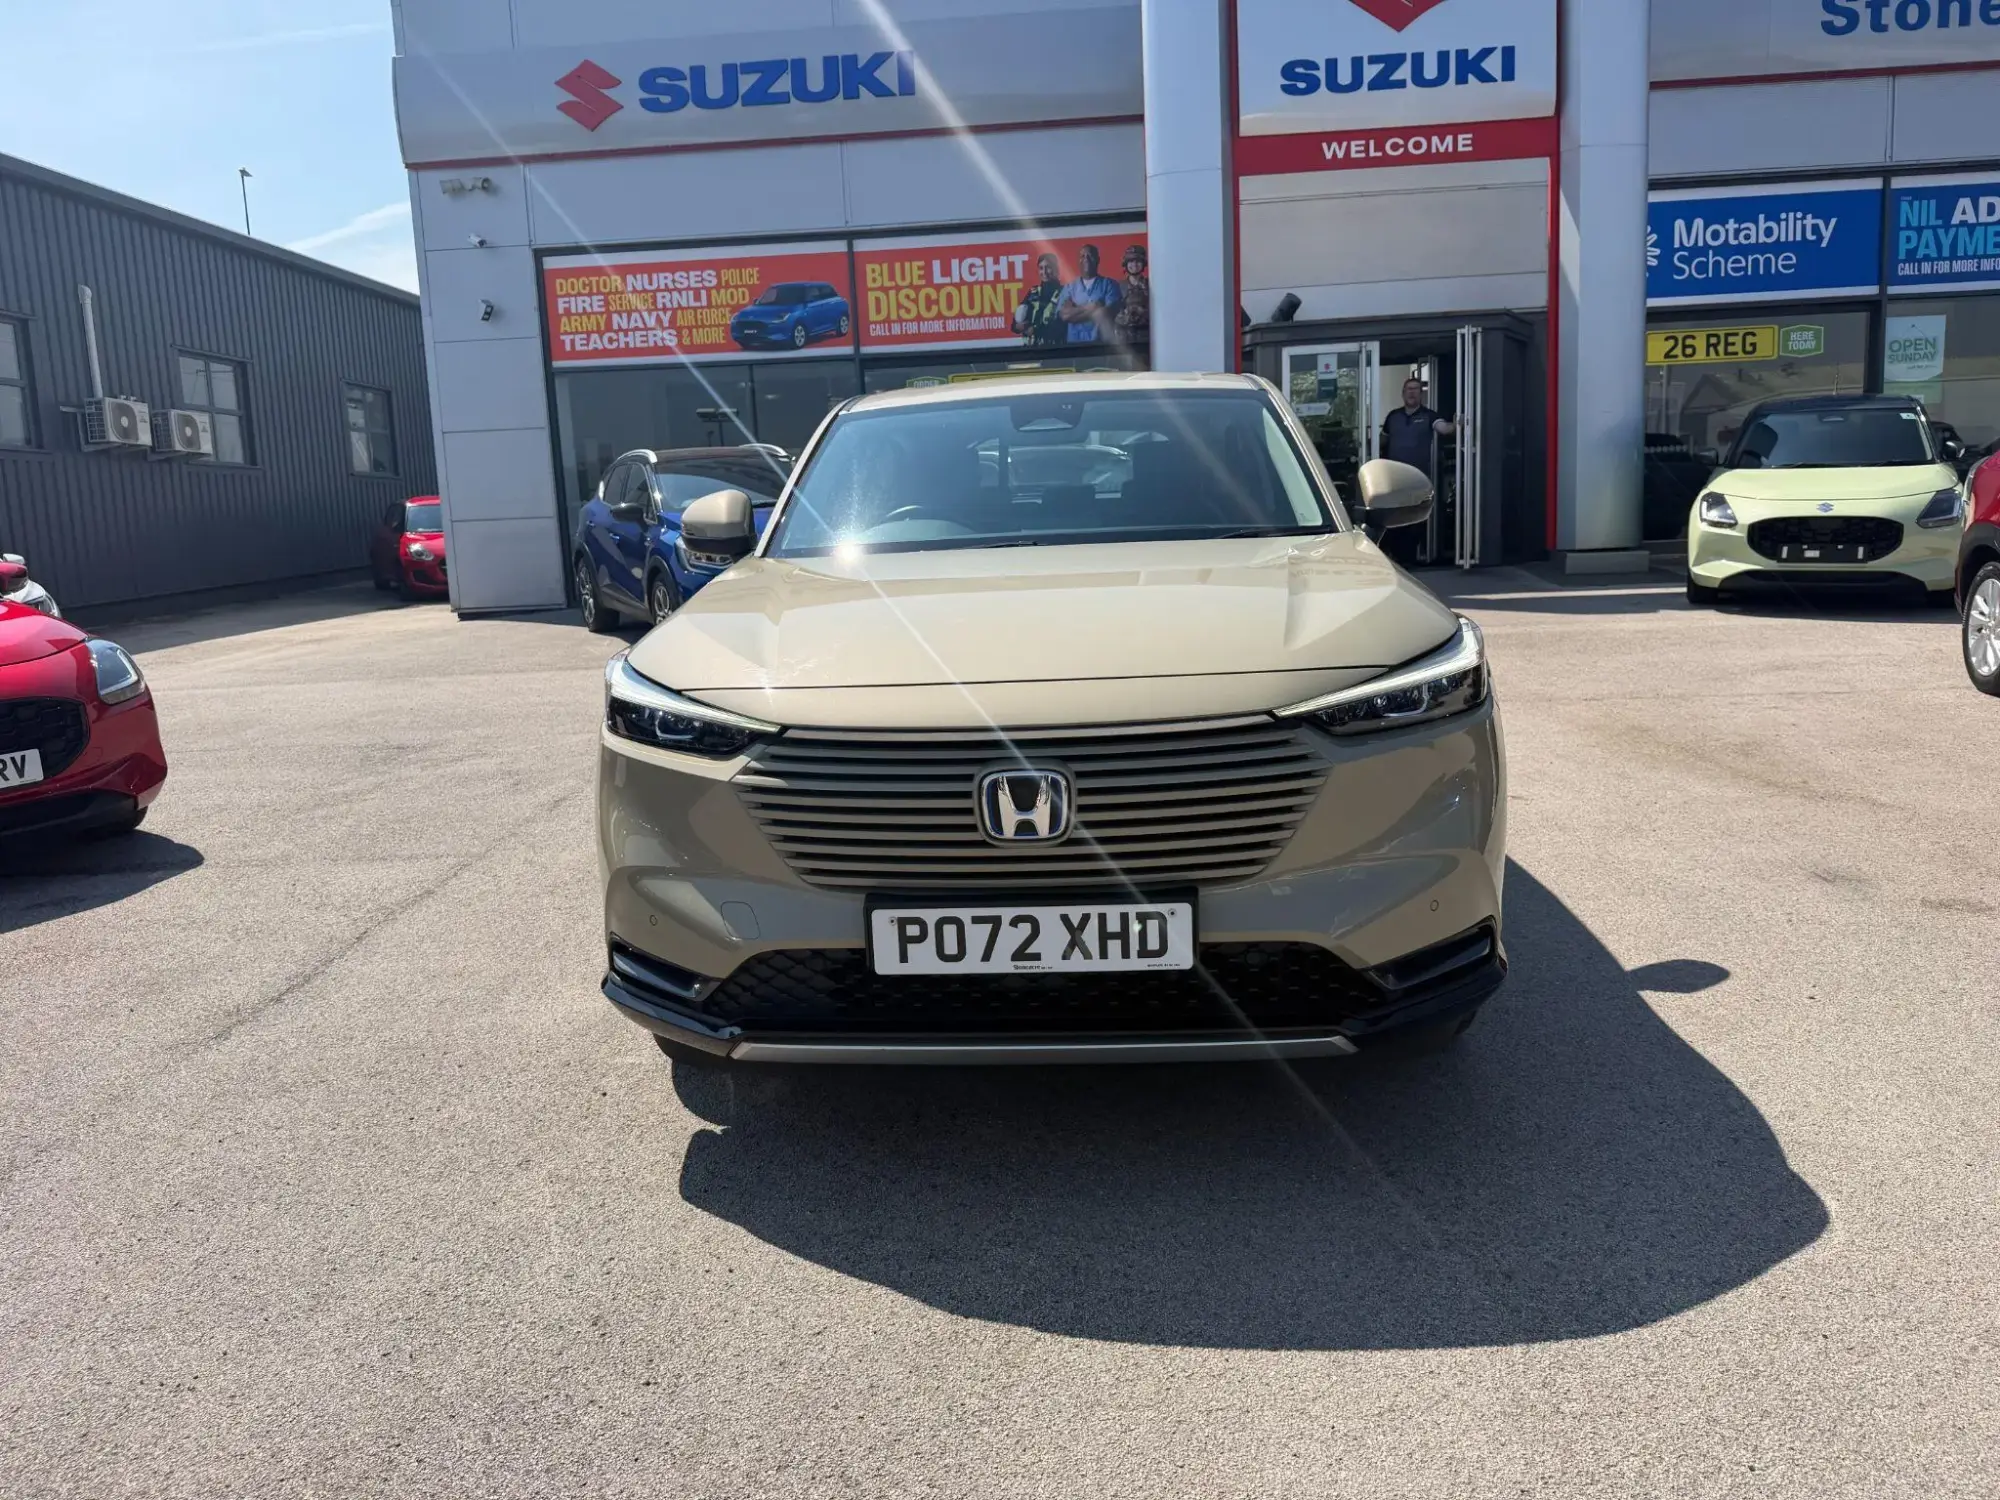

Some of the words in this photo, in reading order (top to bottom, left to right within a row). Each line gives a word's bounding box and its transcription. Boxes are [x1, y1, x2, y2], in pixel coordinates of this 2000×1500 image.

[638, 51, 915, 113] SUZUKI
[1280, 45, 1516, 96] SUZUKI
[1321, 133, 1474, 160] WELCOME
[1900, 199, 1943, 227] NIL
[1950, 196, 2000, 225] AD
[1673, 211, 1837, 248] Motability
[1898, 225, 2000, 260] PAYME
[865, 260, 926, 288] BLUE
[932, 254, 1029, 285] LIGHT
[1672, 250, 1797, 280] Scheme
[1898, 262, 1920, 276] CALL
[1921, 261, 1932, 274] IN
[1933, 260, 1950, 274] FOR
[1952, 259, 1978, 273] MORE
[555, 273, 622, 296] DOCTOR
[626, 270, 718, 292] NURSES
[721, 267, 760, 286] POLICE
[557, 294, 606, 315] FIRE
[608, 292, 655, 312] SERVICE
[656, 290, 707, 309] RNLI
[710, 287, 750, 306] MOD
[868, 282, 1023, 322] DISCOUNT
[560, 314, 607, 334] ARMY
[611, 311, 673, 330] NAVY
[676, 309, 697, 327] AIR
[698, 307, 732, 326] FORCE
[869, 322, 890, 337] CALL
[891, 321, 901, 335] IN
[902, 320, 918, 335] FOR
[920, 319, 944, 334] MORE
[946, 316, 1005, 333] INFORMATION
[560, 328, 678, 352] TEACHERS
[682, 329, 691, 345] &
[692, 327, 727, 345] MORE
[1663, 334, 1697, 360] 26
[1705, 331, 1758, 357] REG
[1787, 339, 1817, 351] TODAY
[1790, 331, 1815, 341] HERE
[1889, 336, 1937, 353] OPEN
[1887, 351, 1937, 364] SUNDAY
[896, 914, 1042, 963] PO72
[1059, 910, 1169, 961] XHD
